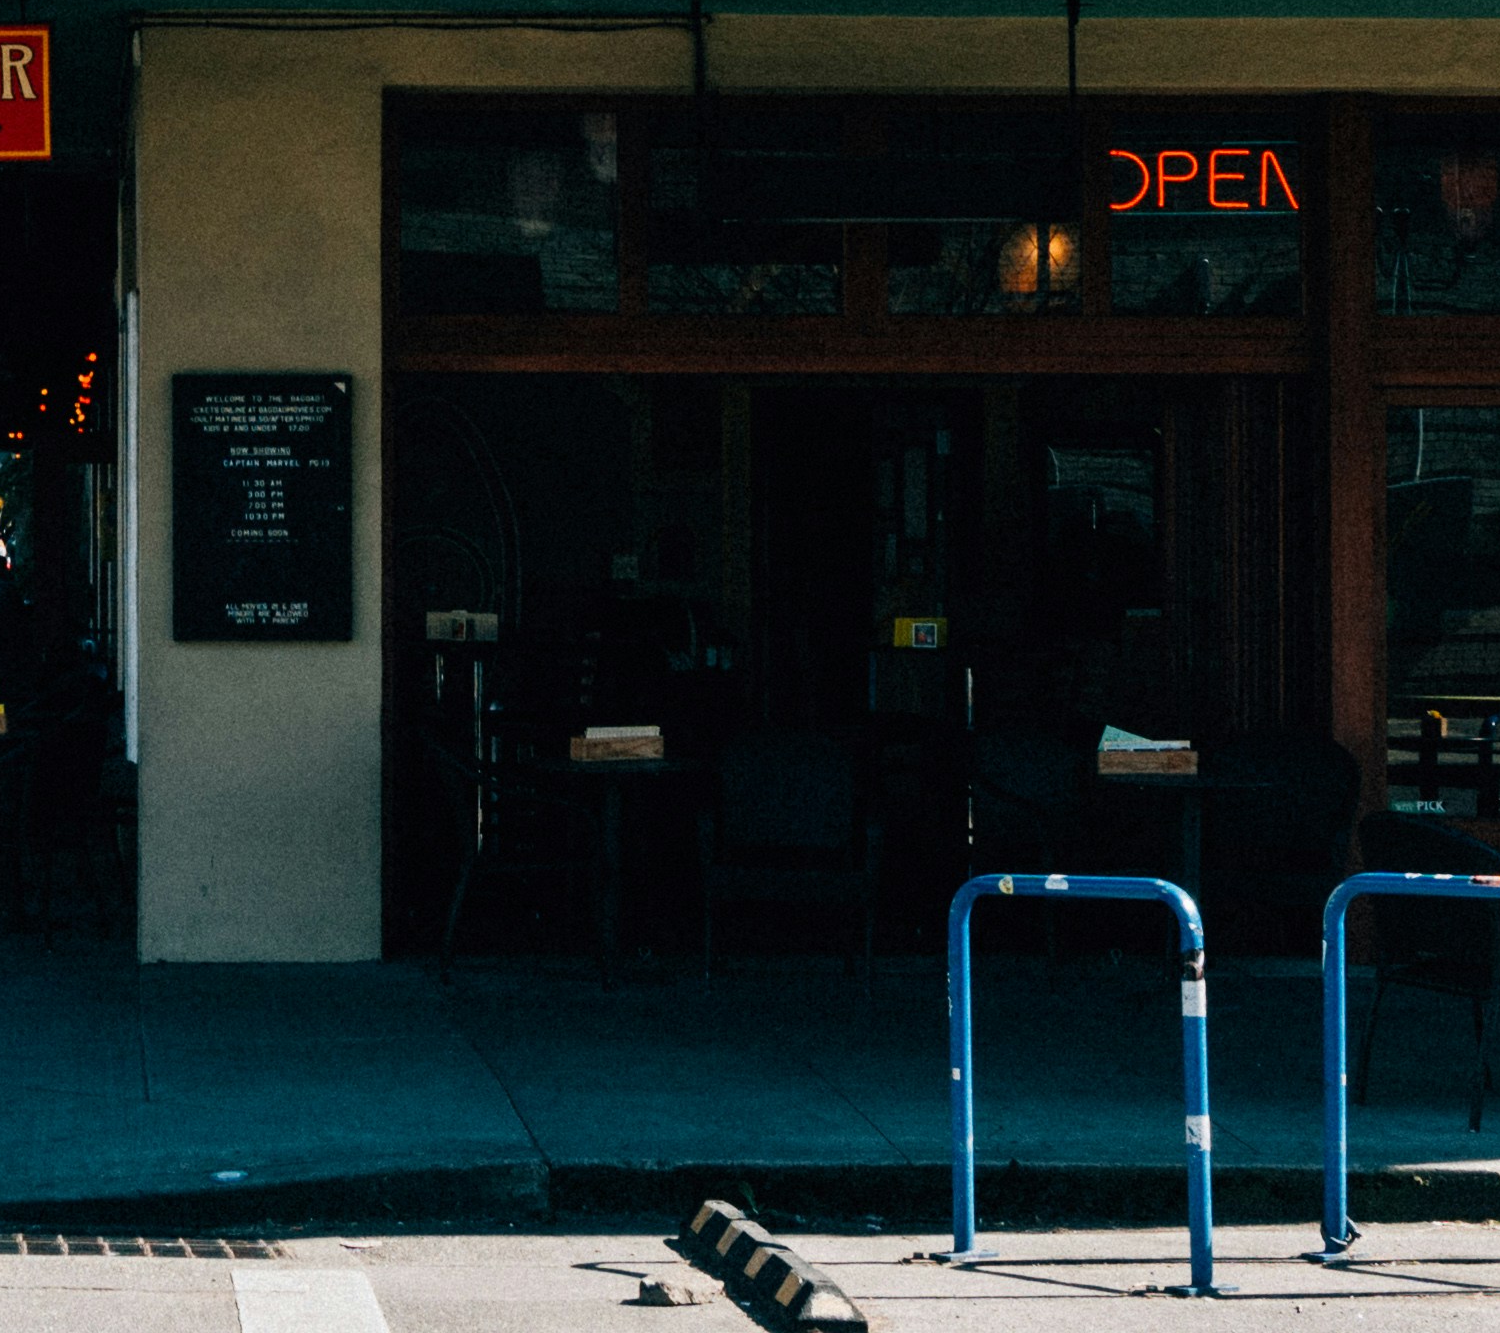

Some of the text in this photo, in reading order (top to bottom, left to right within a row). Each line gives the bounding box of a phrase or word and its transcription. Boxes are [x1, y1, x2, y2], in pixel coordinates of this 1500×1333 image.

[1110, 148, 1299, 210] OPEN
[205, 395, 246, 403] WELCOME
[269, 395, 283, 403] THE
[230, 447, 291, 456] NOW SHOWING
[223, 459, 260, 467] CAPTAIN
[266, 459, 300, 467] MARVEL
[271, 512, 285, 520] PM
[231, 529, 289, 537] COMING SOON
